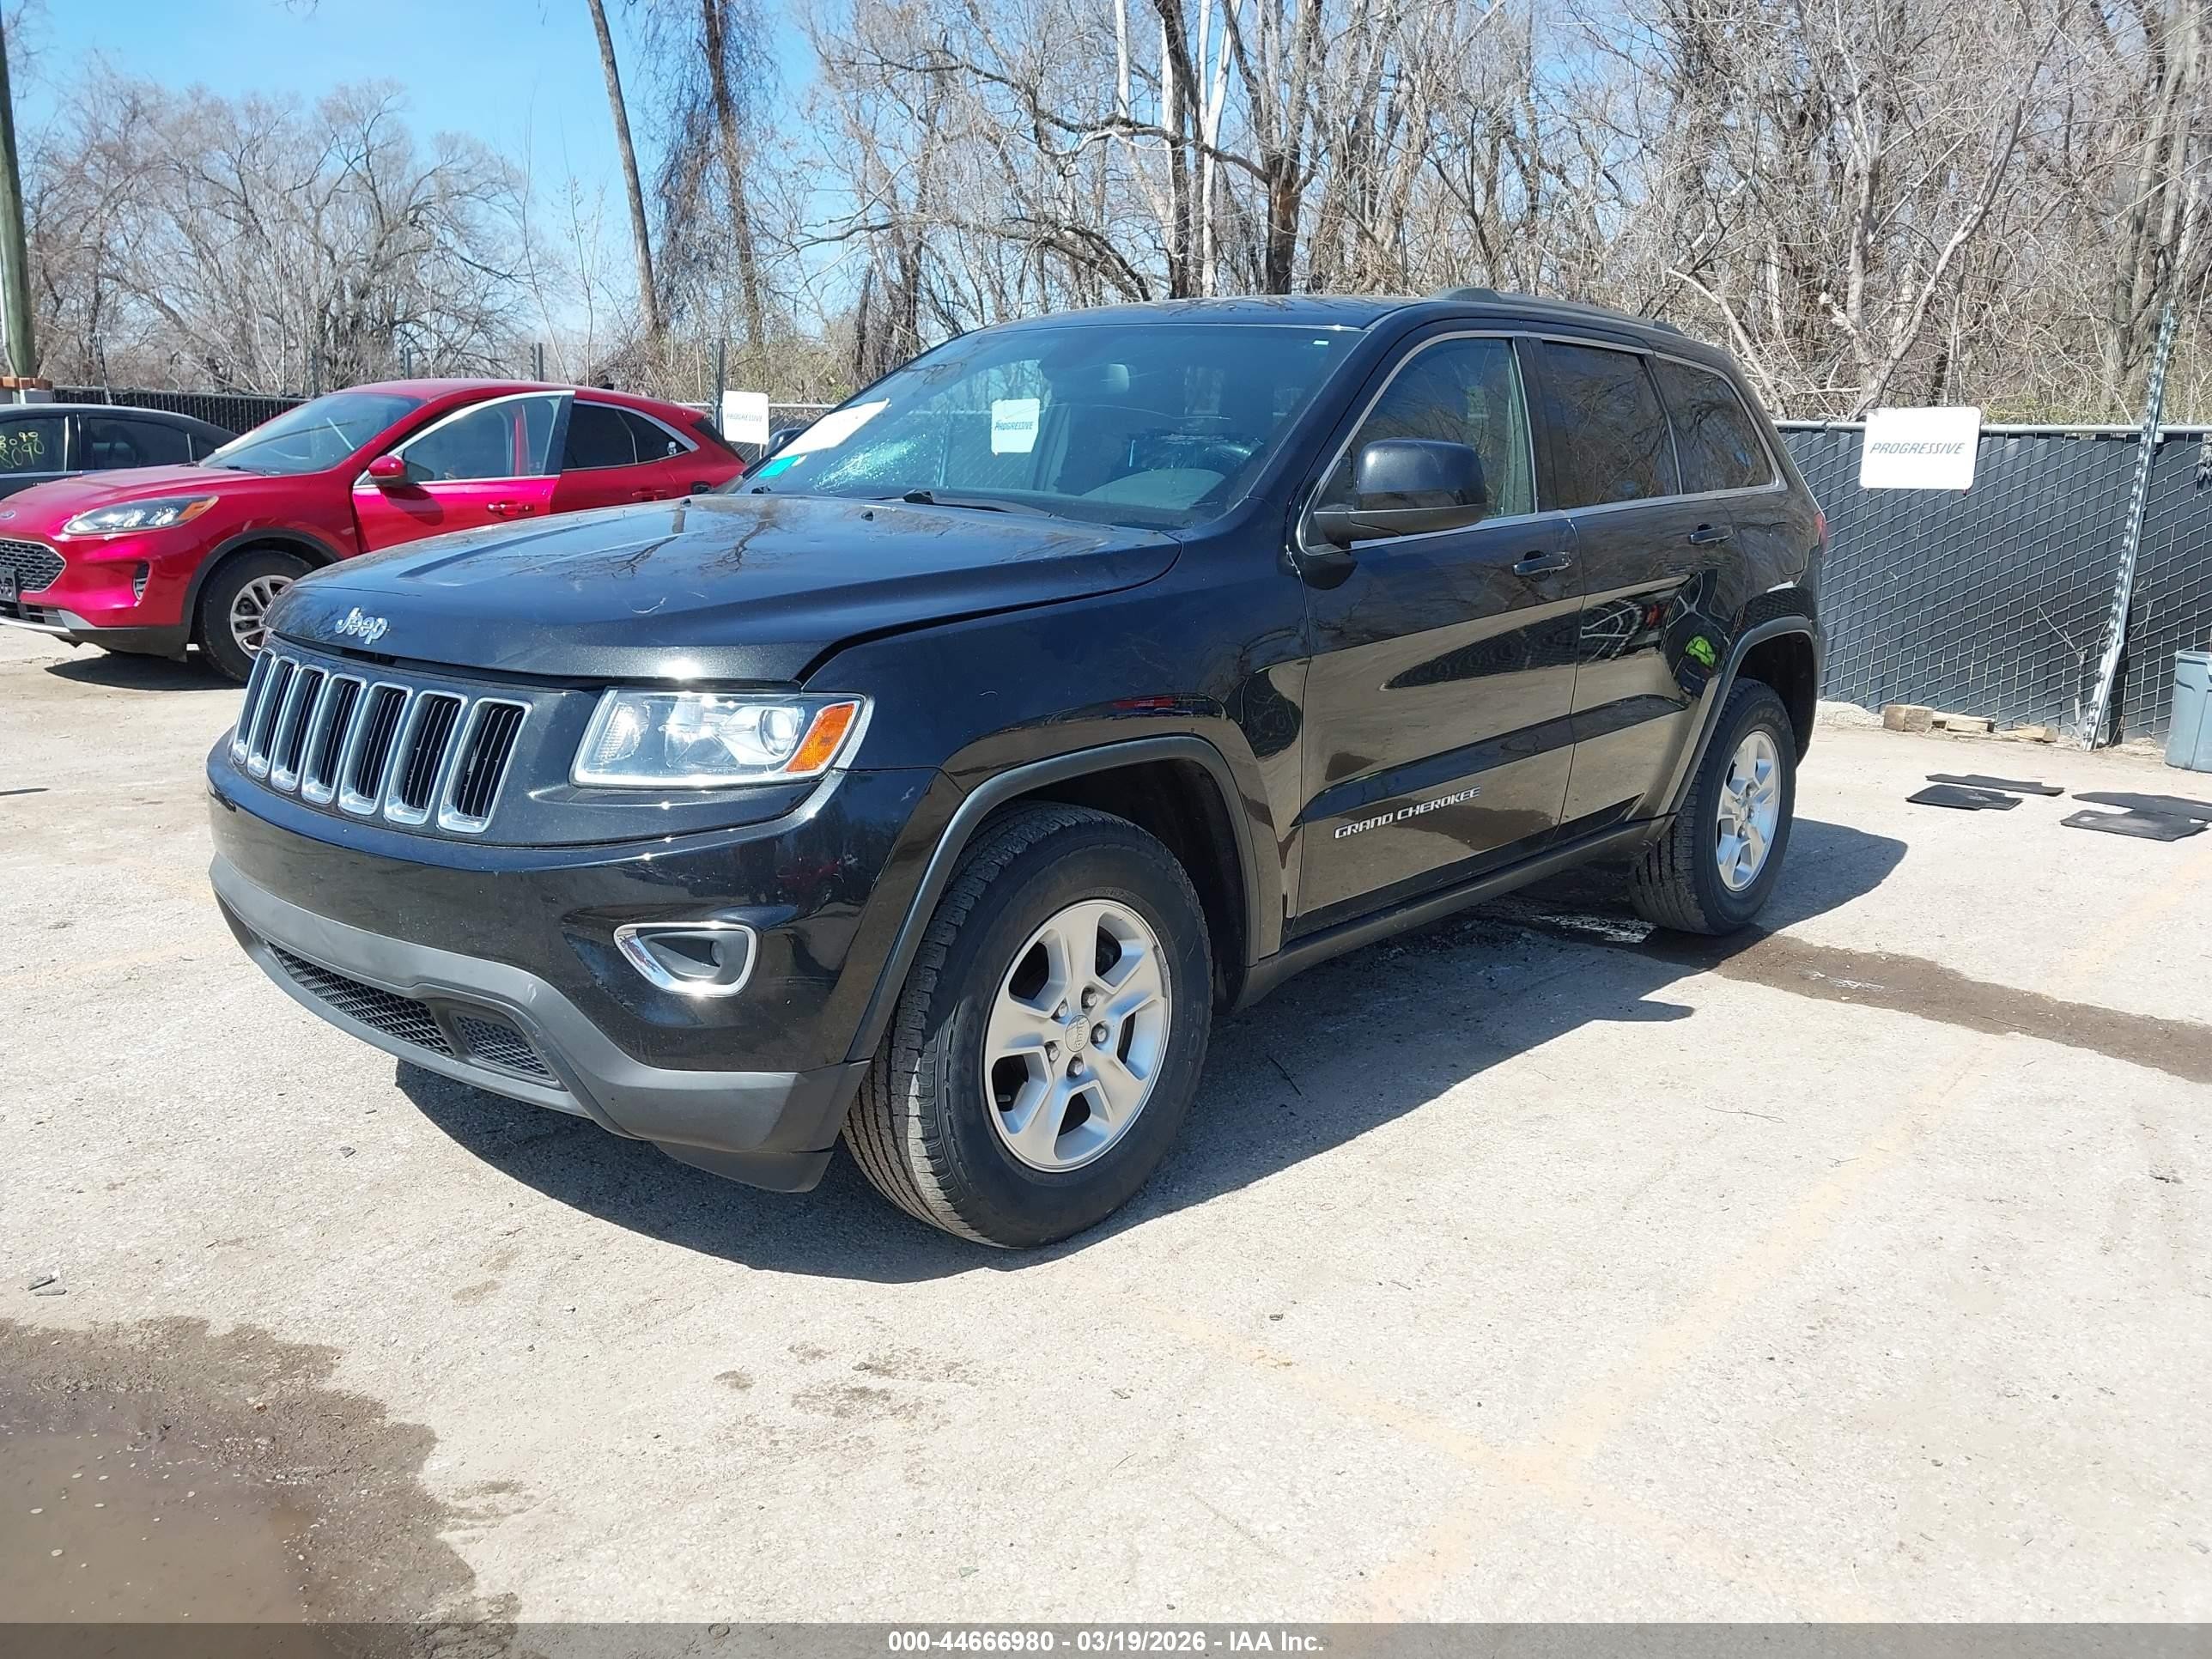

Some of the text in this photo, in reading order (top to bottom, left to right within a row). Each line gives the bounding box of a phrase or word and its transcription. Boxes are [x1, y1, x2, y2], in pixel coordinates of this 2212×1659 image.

[1869, 442, 1966, 454] PROGRESSIVE
[335, 606, 388, 645] Jeep
[1334, 786, 1481, 839] GRAND CHEROKEE
